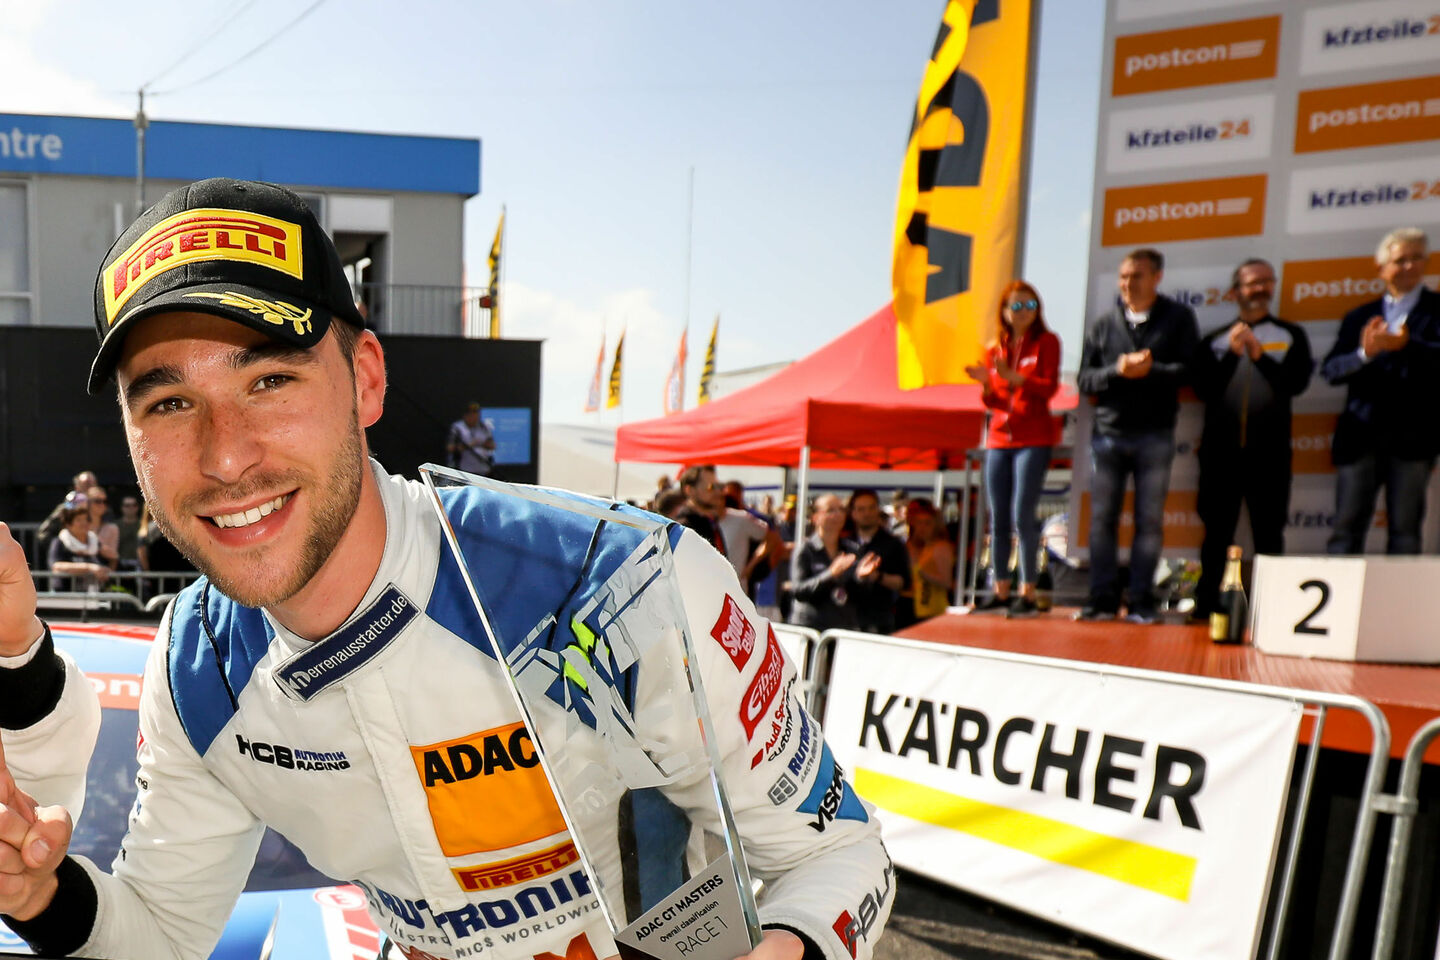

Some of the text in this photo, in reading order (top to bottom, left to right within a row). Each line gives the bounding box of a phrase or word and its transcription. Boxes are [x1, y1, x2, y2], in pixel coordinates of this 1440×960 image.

[1125, 44, 1227, 77] postcon
[1127, 120, 1251, 149] kfzteile24
[1309, 100, 1421, 132] postcon
[1115, 200, 1215, 228] postcon
[113, 215, 287, 300] PIRELLI
[1294, 280, 1386, 302] postco
[1293, 579, 1331, 635] 2
[235, 734, 347, 770] HCB RUTRONIK
[423, 727, 542, 787] ADAC
[765, 721, 782, 755] Audi
[296, 760, 351, 771] RACING
[858, 688, 1208, 832] KÄRCHER
[457, 843, 578, 890] PIRELLI
[635, 874, 724, 941] ADAC GT MASTERS
[660, 900, 720, 943] Overall classification
[675, 915, 729, 957] RACE 1
